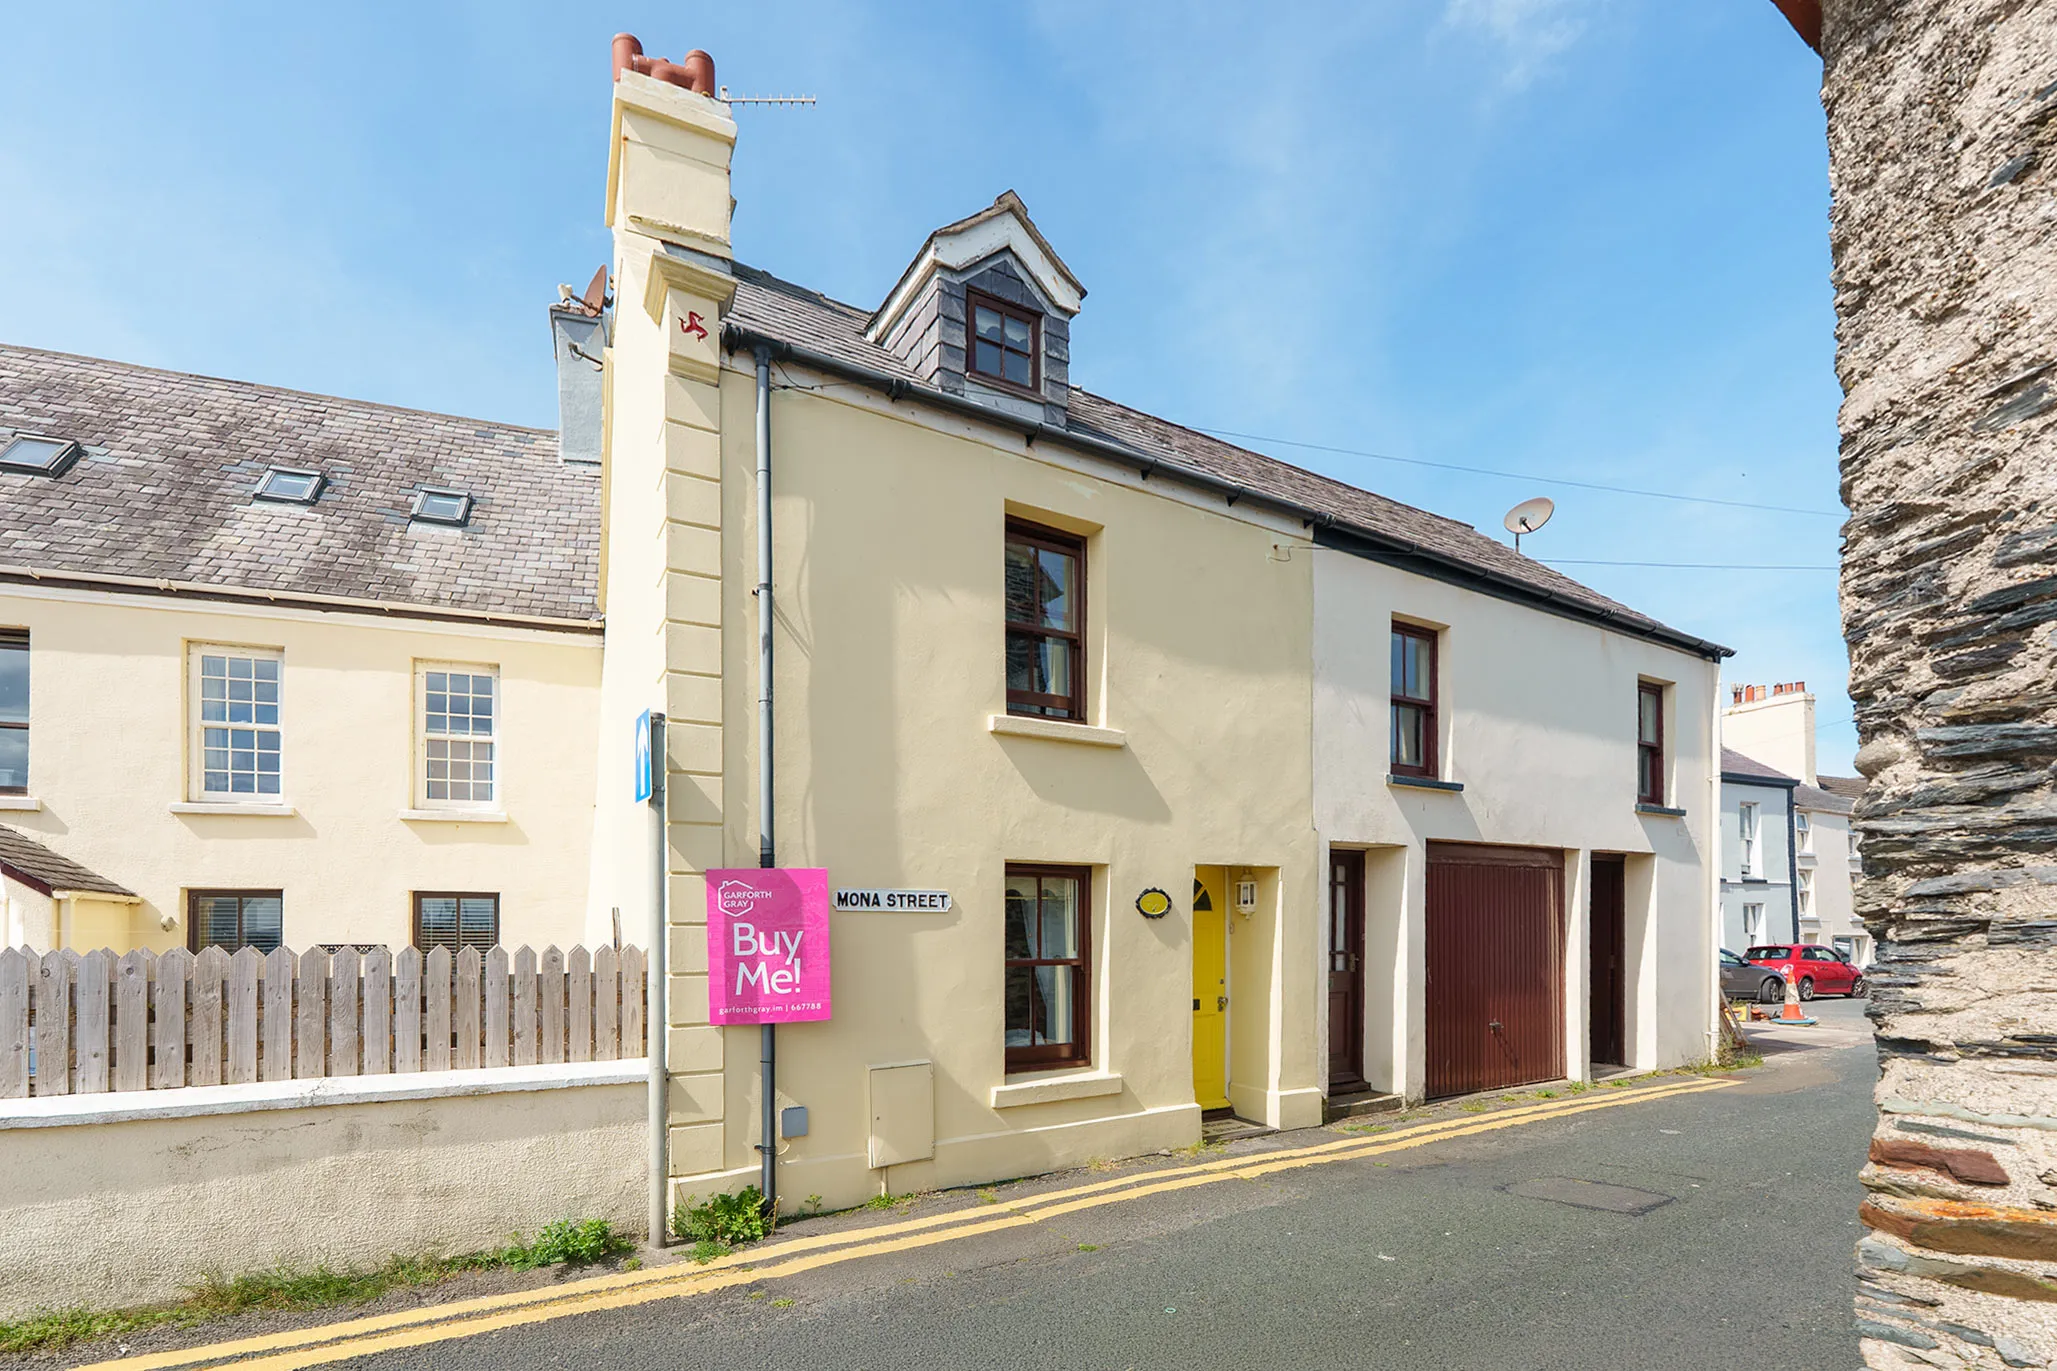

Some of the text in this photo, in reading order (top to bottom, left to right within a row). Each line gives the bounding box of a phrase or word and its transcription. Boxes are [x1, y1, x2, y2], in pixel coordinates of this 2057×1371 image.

[723, 891, 772, 900] GARFORTH
[837, 892, 948, 908] MONA STREET
[723, 900, 748, 908] GRAY
[734, 923, 803, 965] Buy
[735, 958, 801, 996] Me!
[719, 1003, 822, 1016] garforthgray.im 667788
